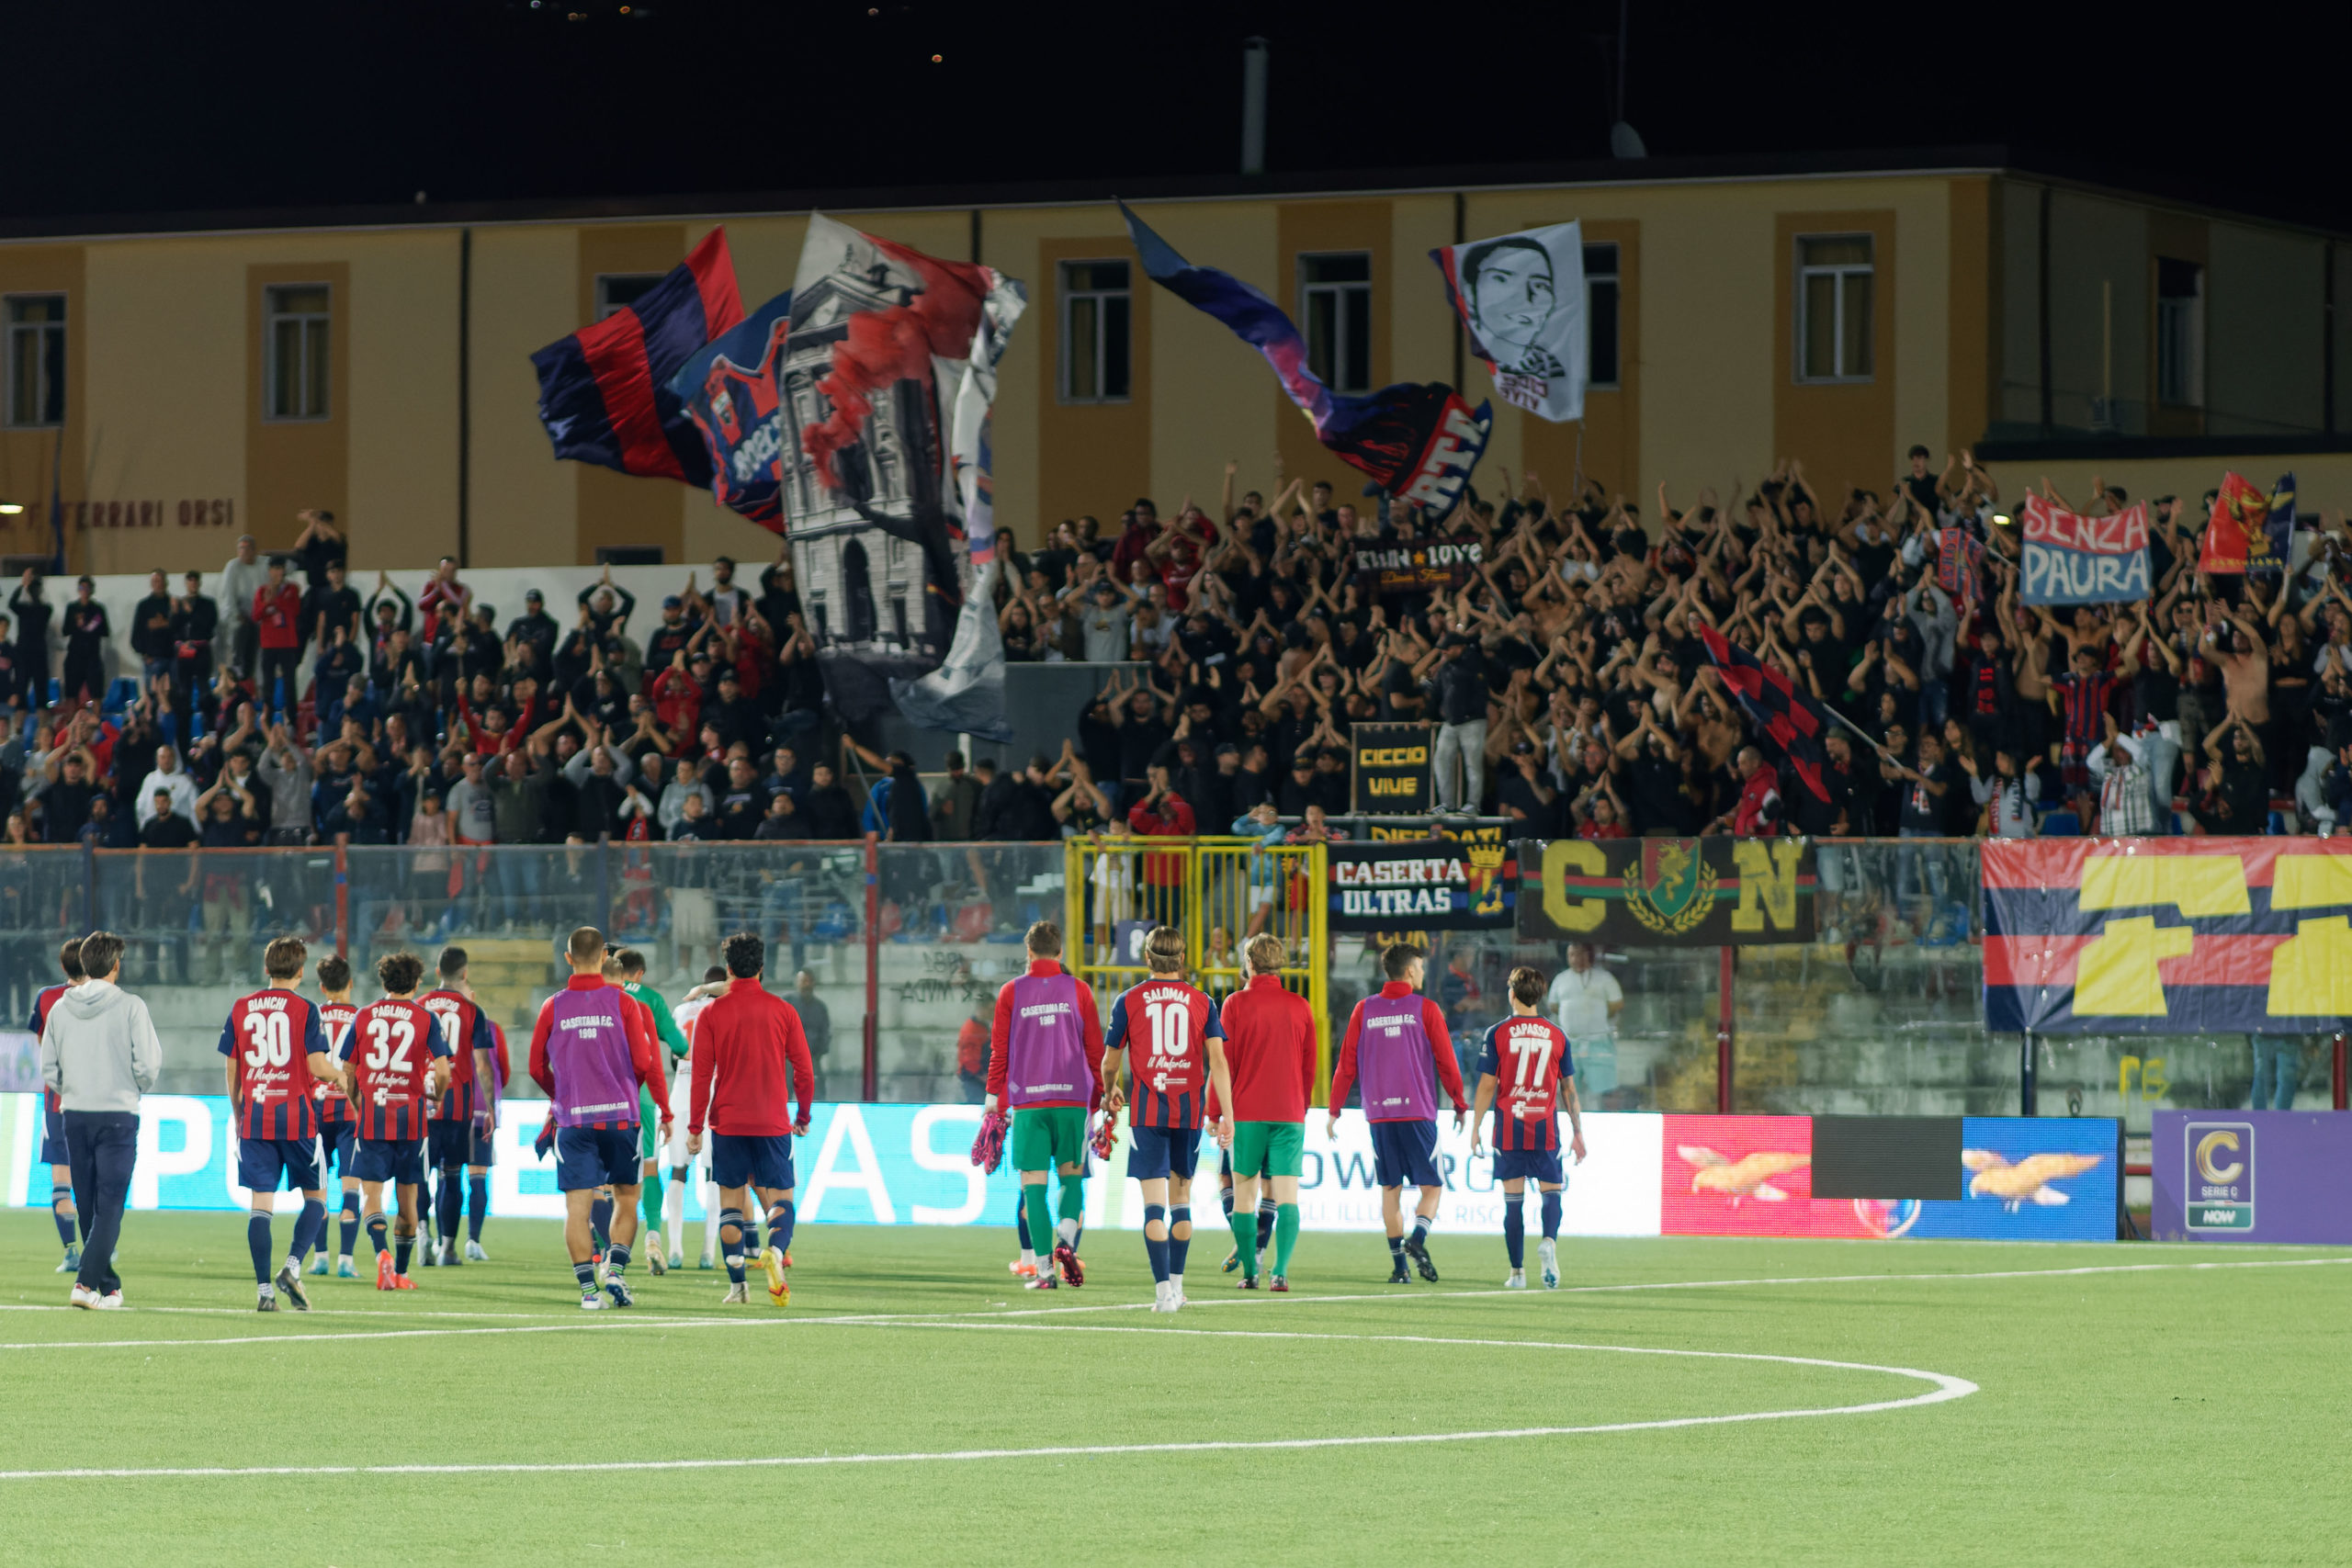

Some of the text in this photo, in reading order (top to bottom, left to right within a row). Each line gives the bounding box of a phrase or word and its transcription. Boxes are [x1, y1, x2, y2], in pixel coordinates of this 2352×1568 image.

[177, 498, 234, 527] ORSI
[2024, 500, 2147, 551] SENZA
[2024, 544, 2149, 597] PAURA
[1359, 745, 1428, 766] CICCIO
[1368, 776, 1419, 795] VIVE
[1336, 858, 1467, 886] CASERTA
[1342, 886, 1452, 915] ULTRAS
[247, 997, 288, 1012] BIANCHI
[1142, 987, 1191, 1006] SALOMAA
[371, 1003, 413, 1021] PAGLINO
[560, 1015, 614, 1031] CASERTANA F.C.
[243, 1010, 291, 1068] 30
[1145, 1002, 1189, 1056] 10
[1509, 1022, 1551, 1040] CAPASSO
[365, 1018, 415, 1073] 32
[1509, 1037, 1553, 1089] 77
[2201, 1186, 2238, 1197] SERIE C
[2203, 1210, 2236, 1224] NOW
